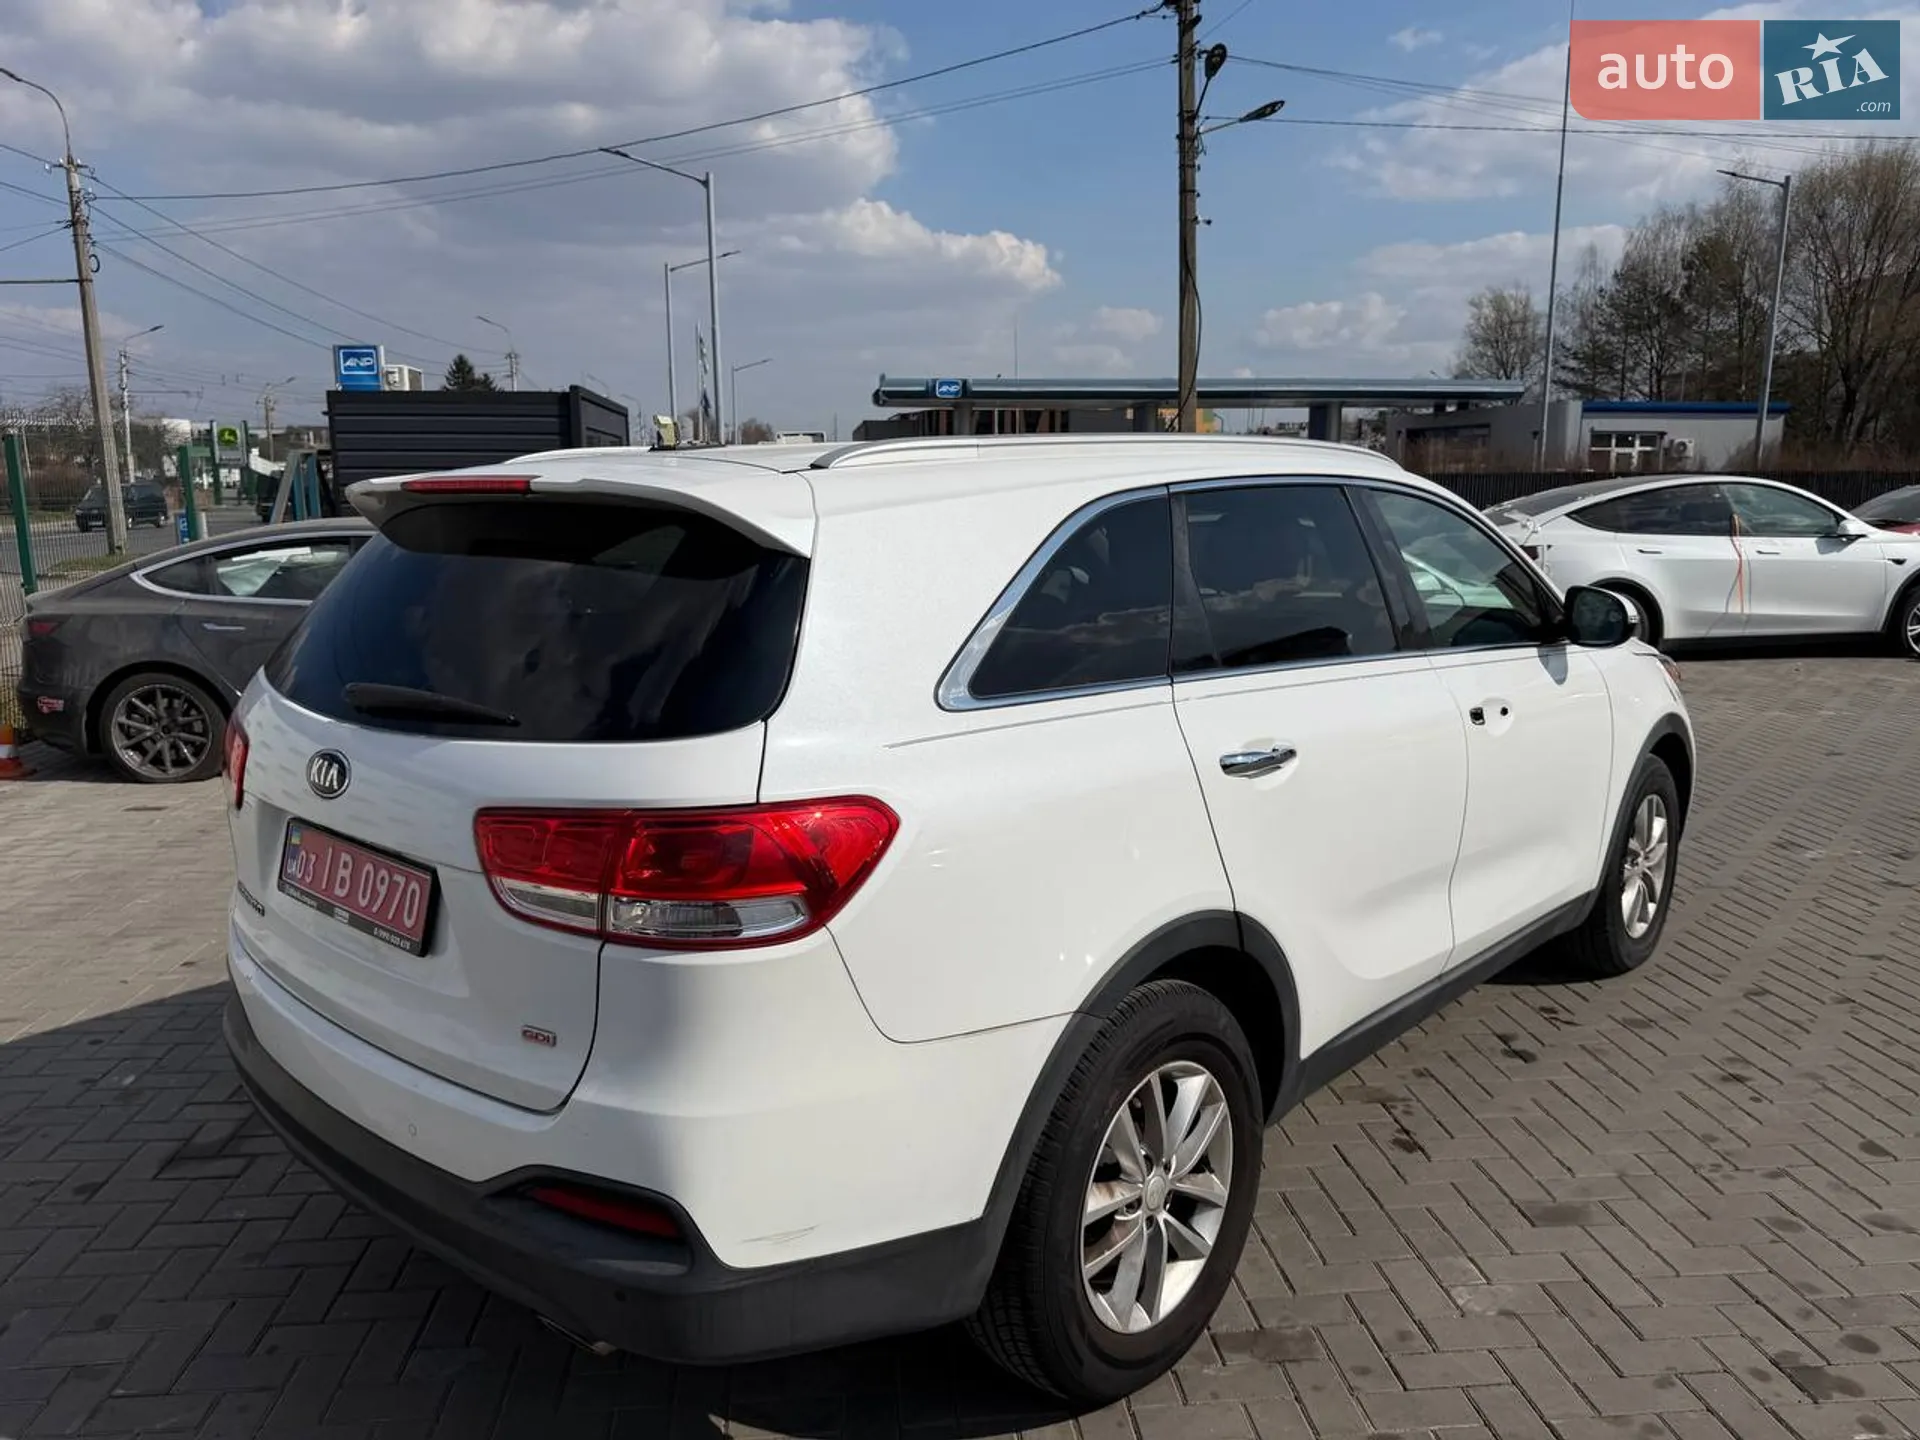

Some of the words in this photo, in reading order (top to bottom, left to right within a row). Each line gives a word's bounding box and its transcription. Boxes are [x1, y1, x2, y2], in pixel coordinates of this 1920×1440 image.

[310, 757, 339, 790] KIA
[297, 850, 316, 883] 03
[358, 862, 420, 929] 0970
